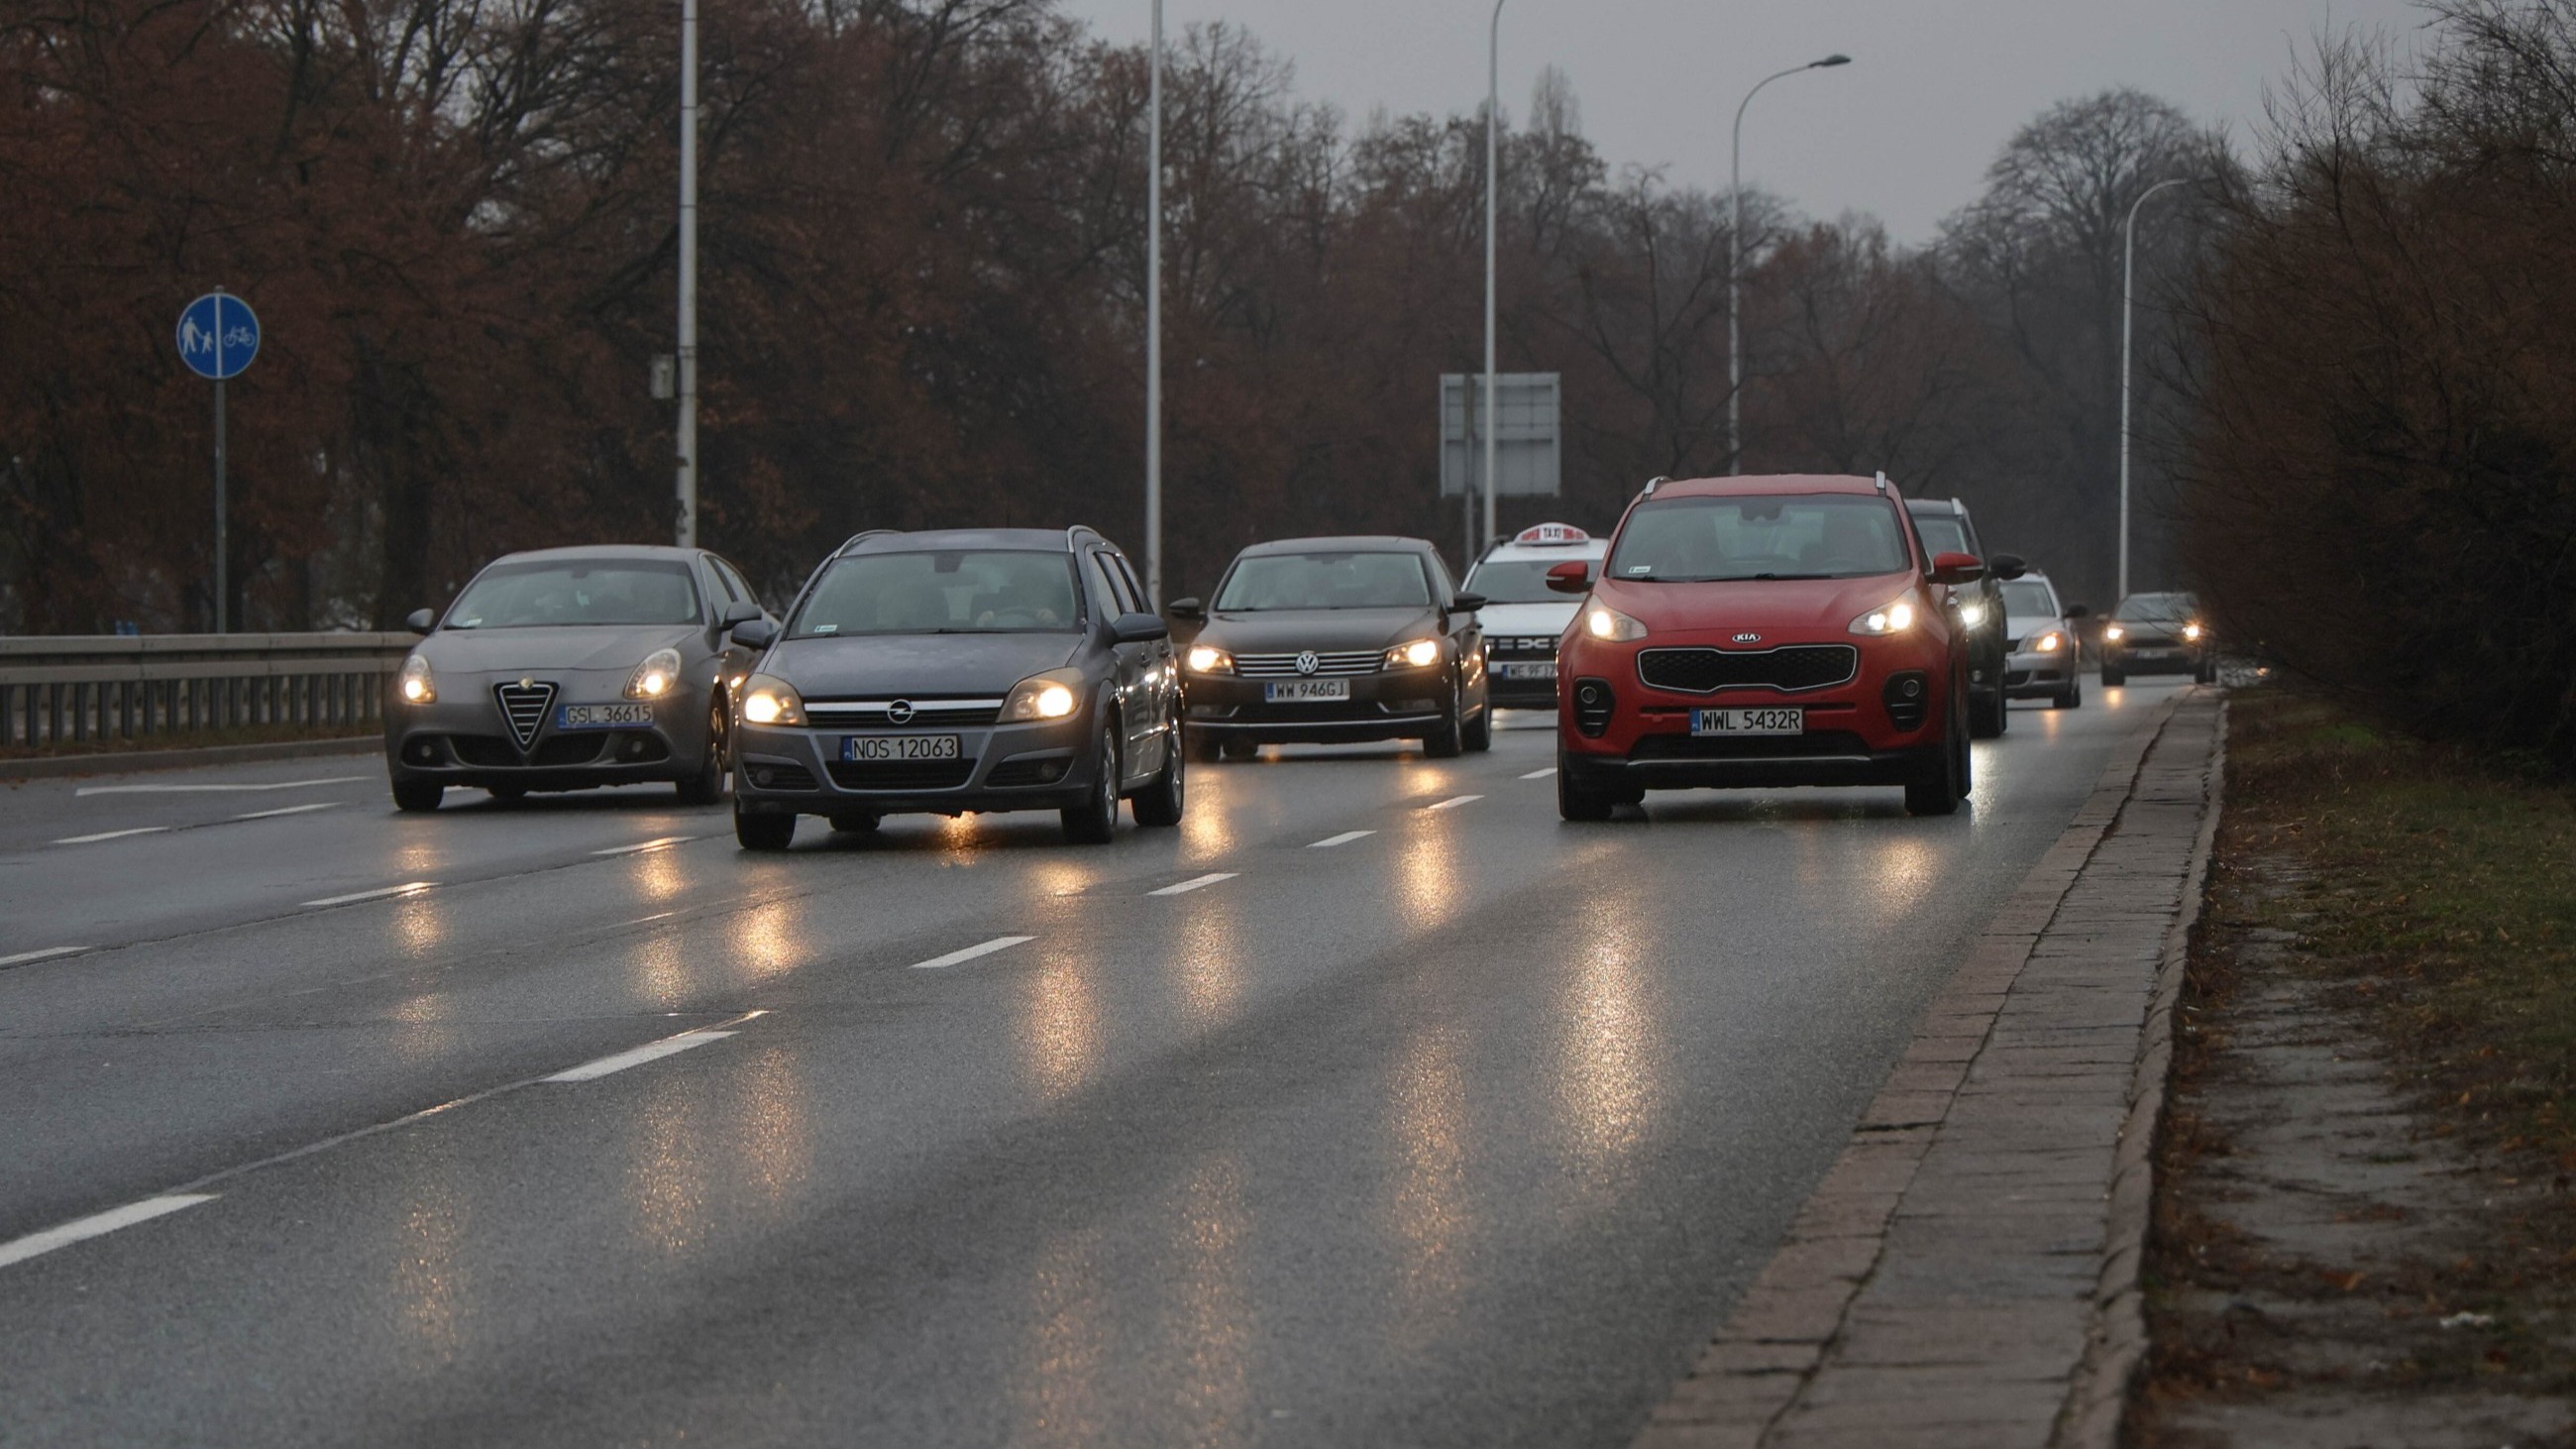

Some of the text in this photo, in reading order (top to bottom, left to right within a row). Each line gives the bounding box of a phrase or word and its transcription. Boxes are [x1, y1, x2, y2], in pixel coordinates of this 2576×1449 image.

[1276, 682, 1343, 698] WW 946GJ
[567, 705, 651, 724] GSL 36615
[1701, 711, 1800, 729] WWL 5432R
[853, 738, 955, 758] NOS 12063
